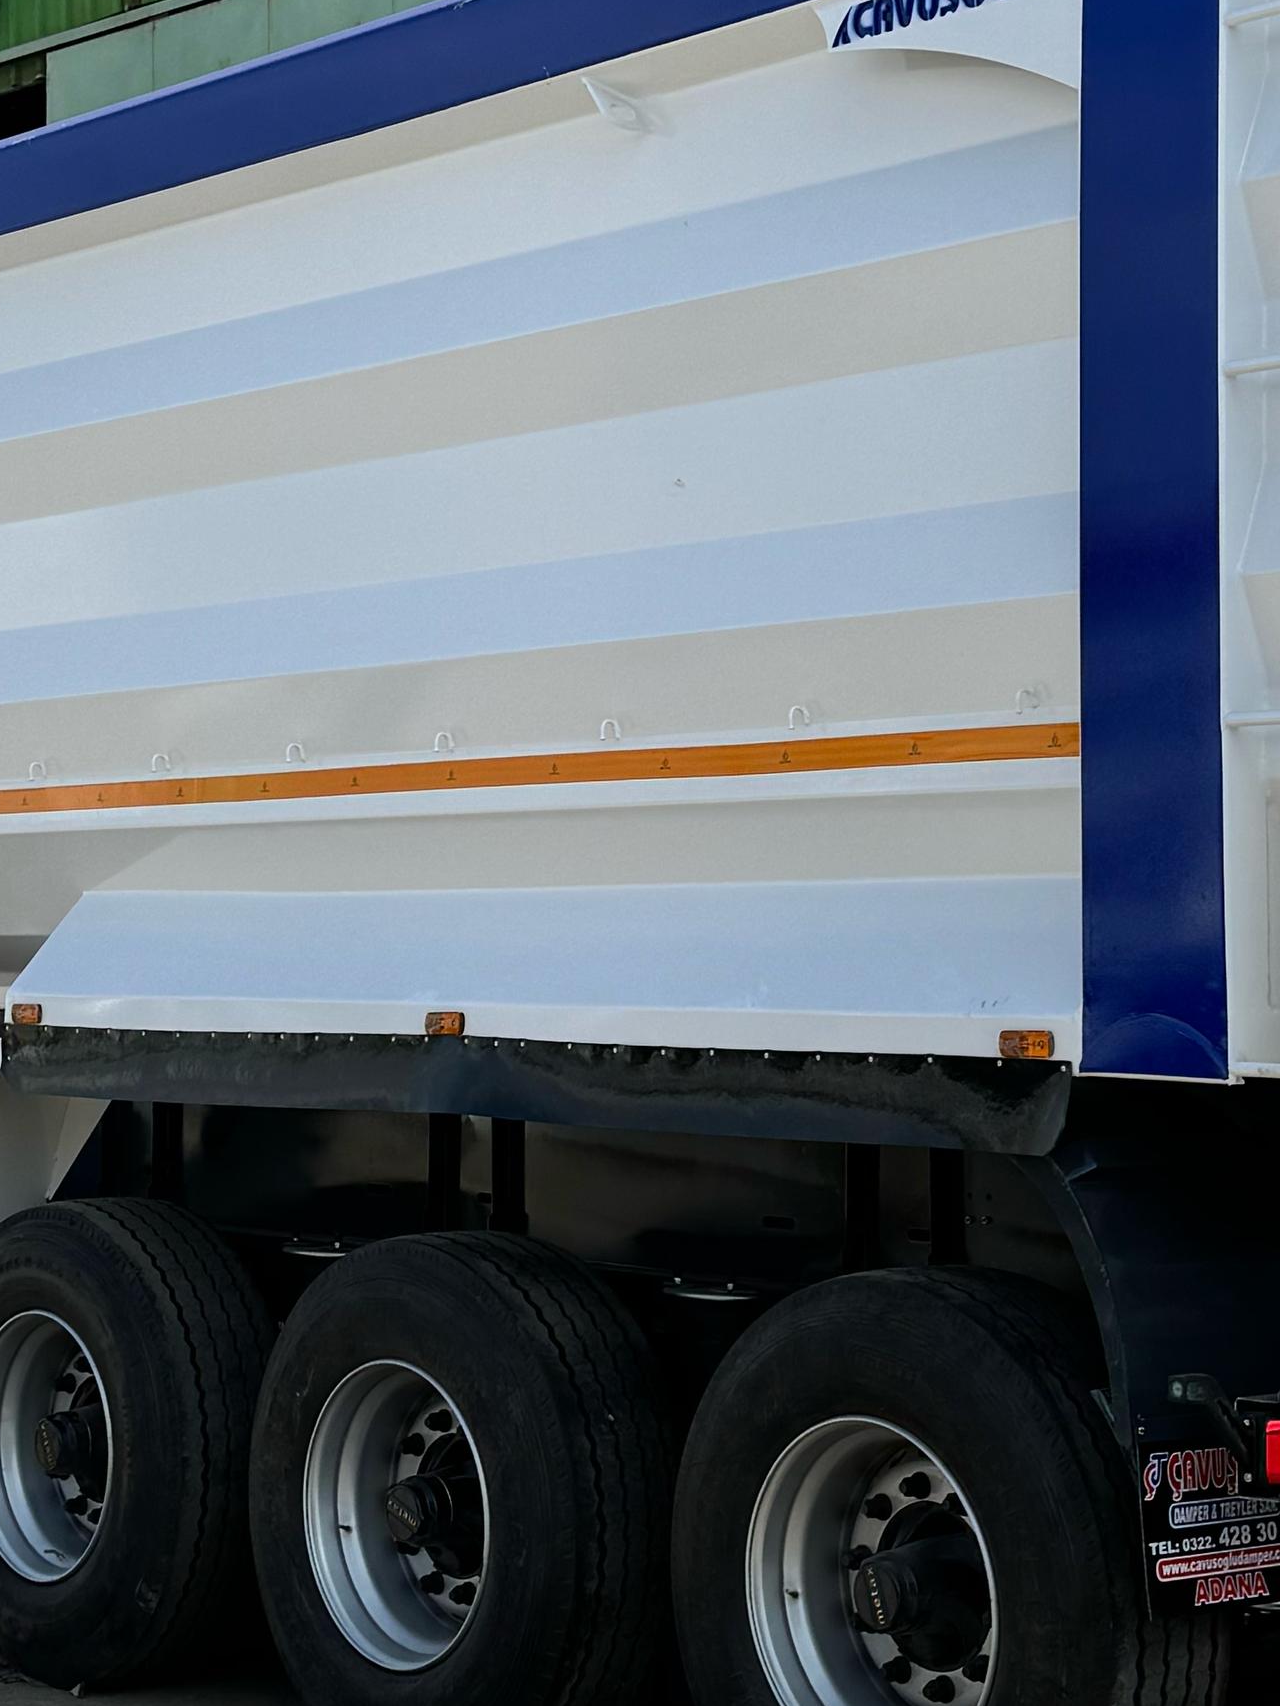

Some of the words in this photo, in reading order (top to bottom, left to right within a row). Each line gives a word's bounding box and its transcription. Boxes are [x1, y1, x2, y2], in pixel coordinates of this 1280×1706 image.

[1173, 1506, 1210, 1525] DAMPER
[1220, 1500, 1258, 1520] TREYLER
[1148, 1541, 1180, 1556] TEL:
[1182, 1536, 1216, 1552] 0322.
[1219, 1524, 1251, 1547] 428
[1256, 1521, 1278, 1542] 30
[1194, 1571, 1270, 1607] ADANA
